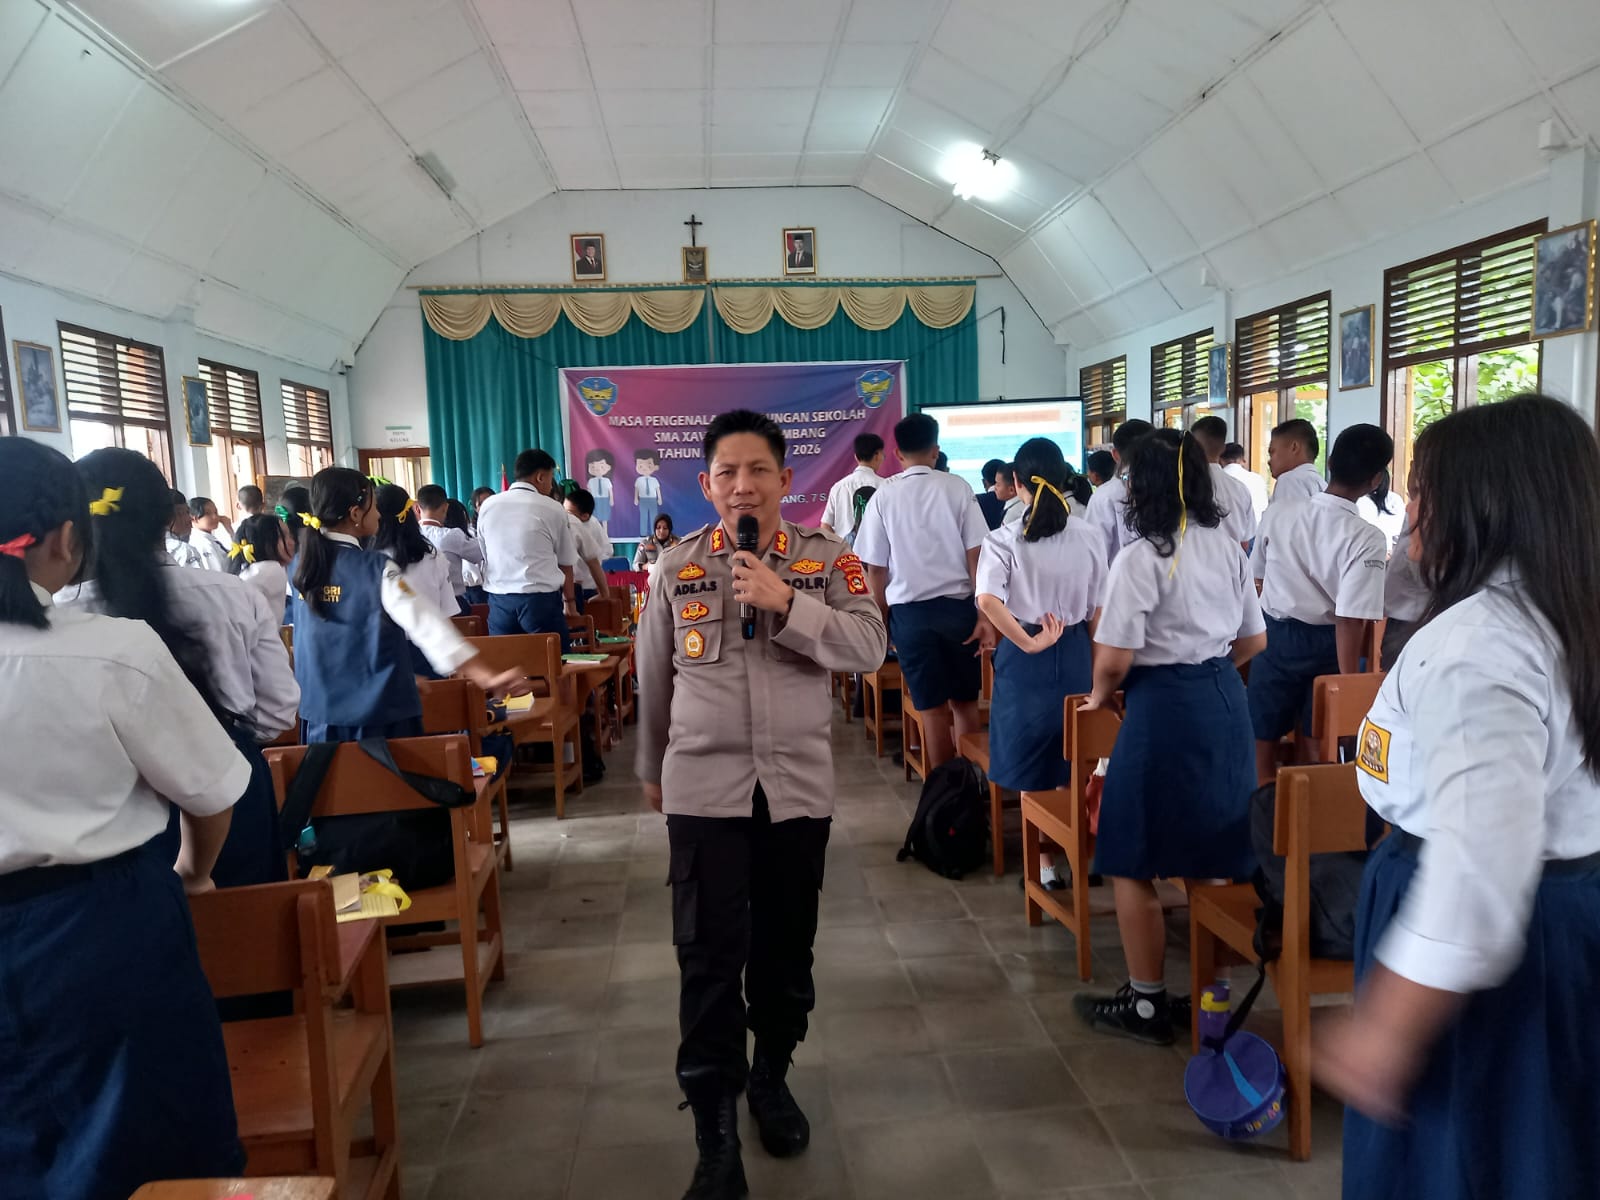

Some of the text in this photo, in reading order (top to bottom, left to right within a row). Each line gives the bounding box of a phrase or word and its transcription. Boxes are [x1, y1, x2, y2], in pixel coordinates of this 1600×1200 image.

[608, 415, 643, 427] MASA
[811, 409, 866, 422] SEKOLAH
[654, 427, 826, 443] SMA XAV MBANG
[657, 448, 701, 459] TAHUN
[792, 444, 821, 456] 2026
[674, 581, 717, 596] ADE.A.S
